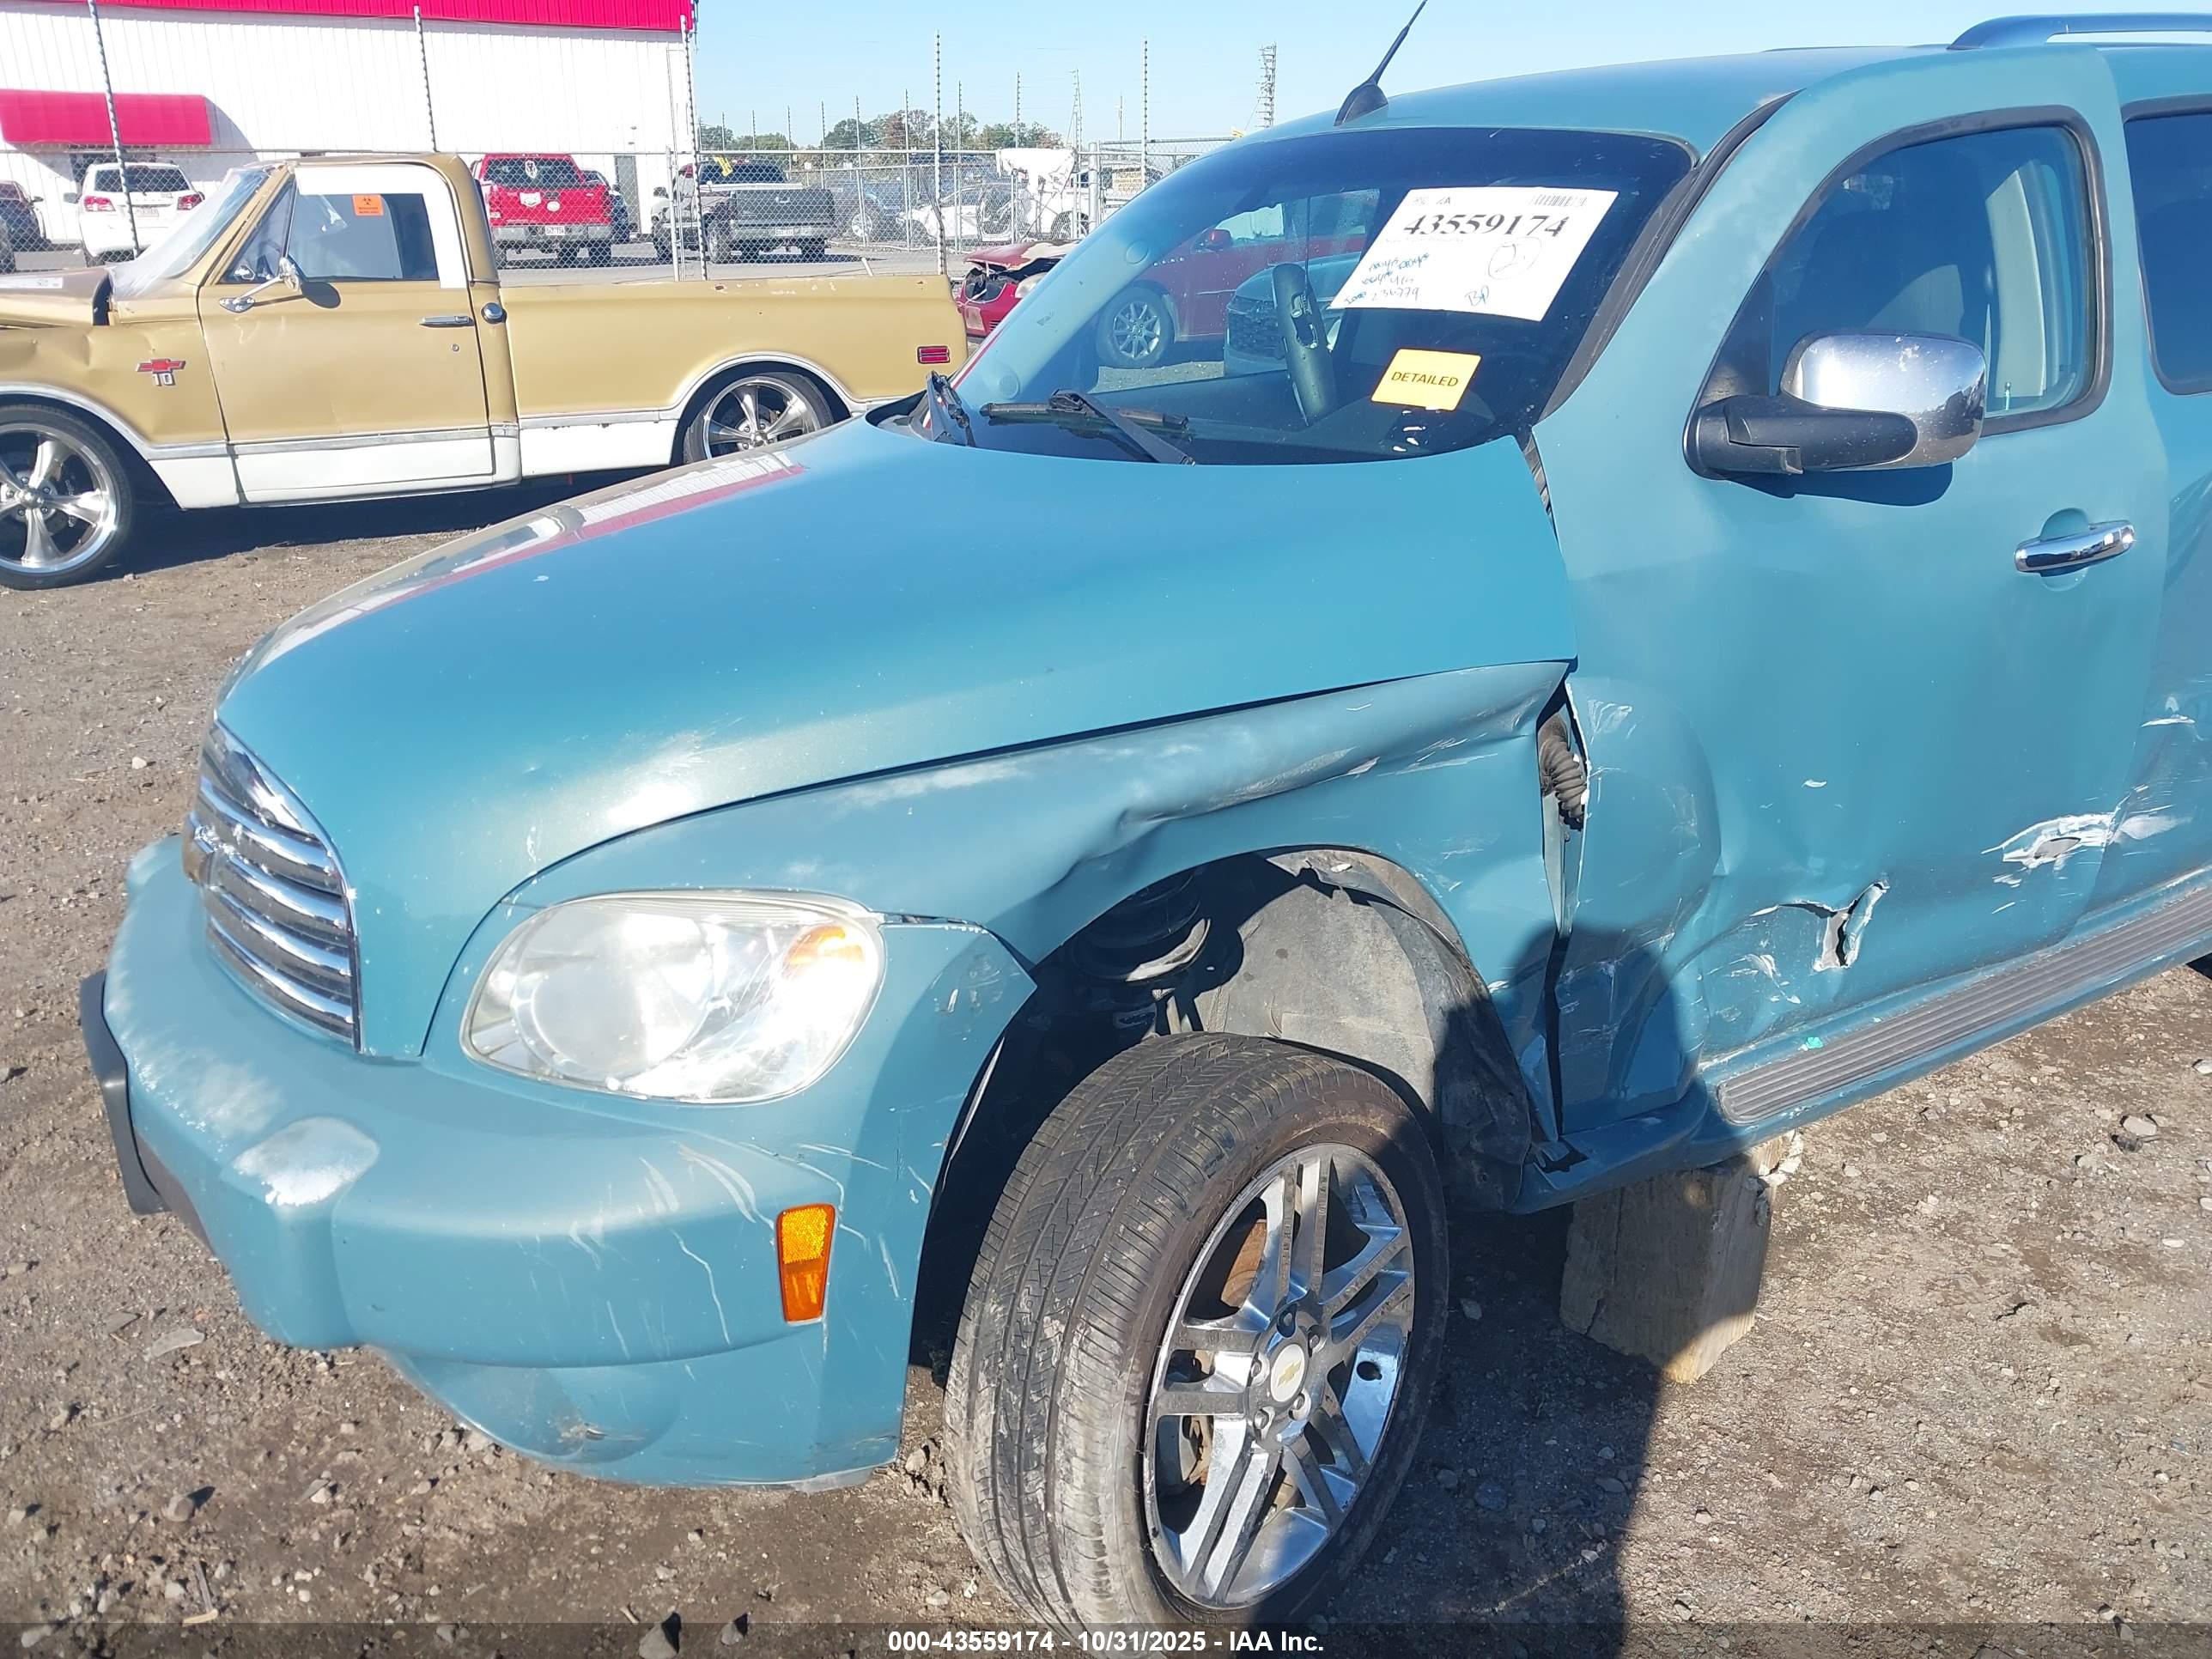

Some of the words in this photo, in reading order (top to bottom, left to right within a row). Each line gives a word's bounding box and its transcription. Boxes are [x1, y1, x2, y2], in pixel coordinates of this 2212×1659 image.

[1403, 214, 1570, 238] 43559174
[152, 373, 175, 386] 10
[1391, 371, 1459, 387] DETAILED
